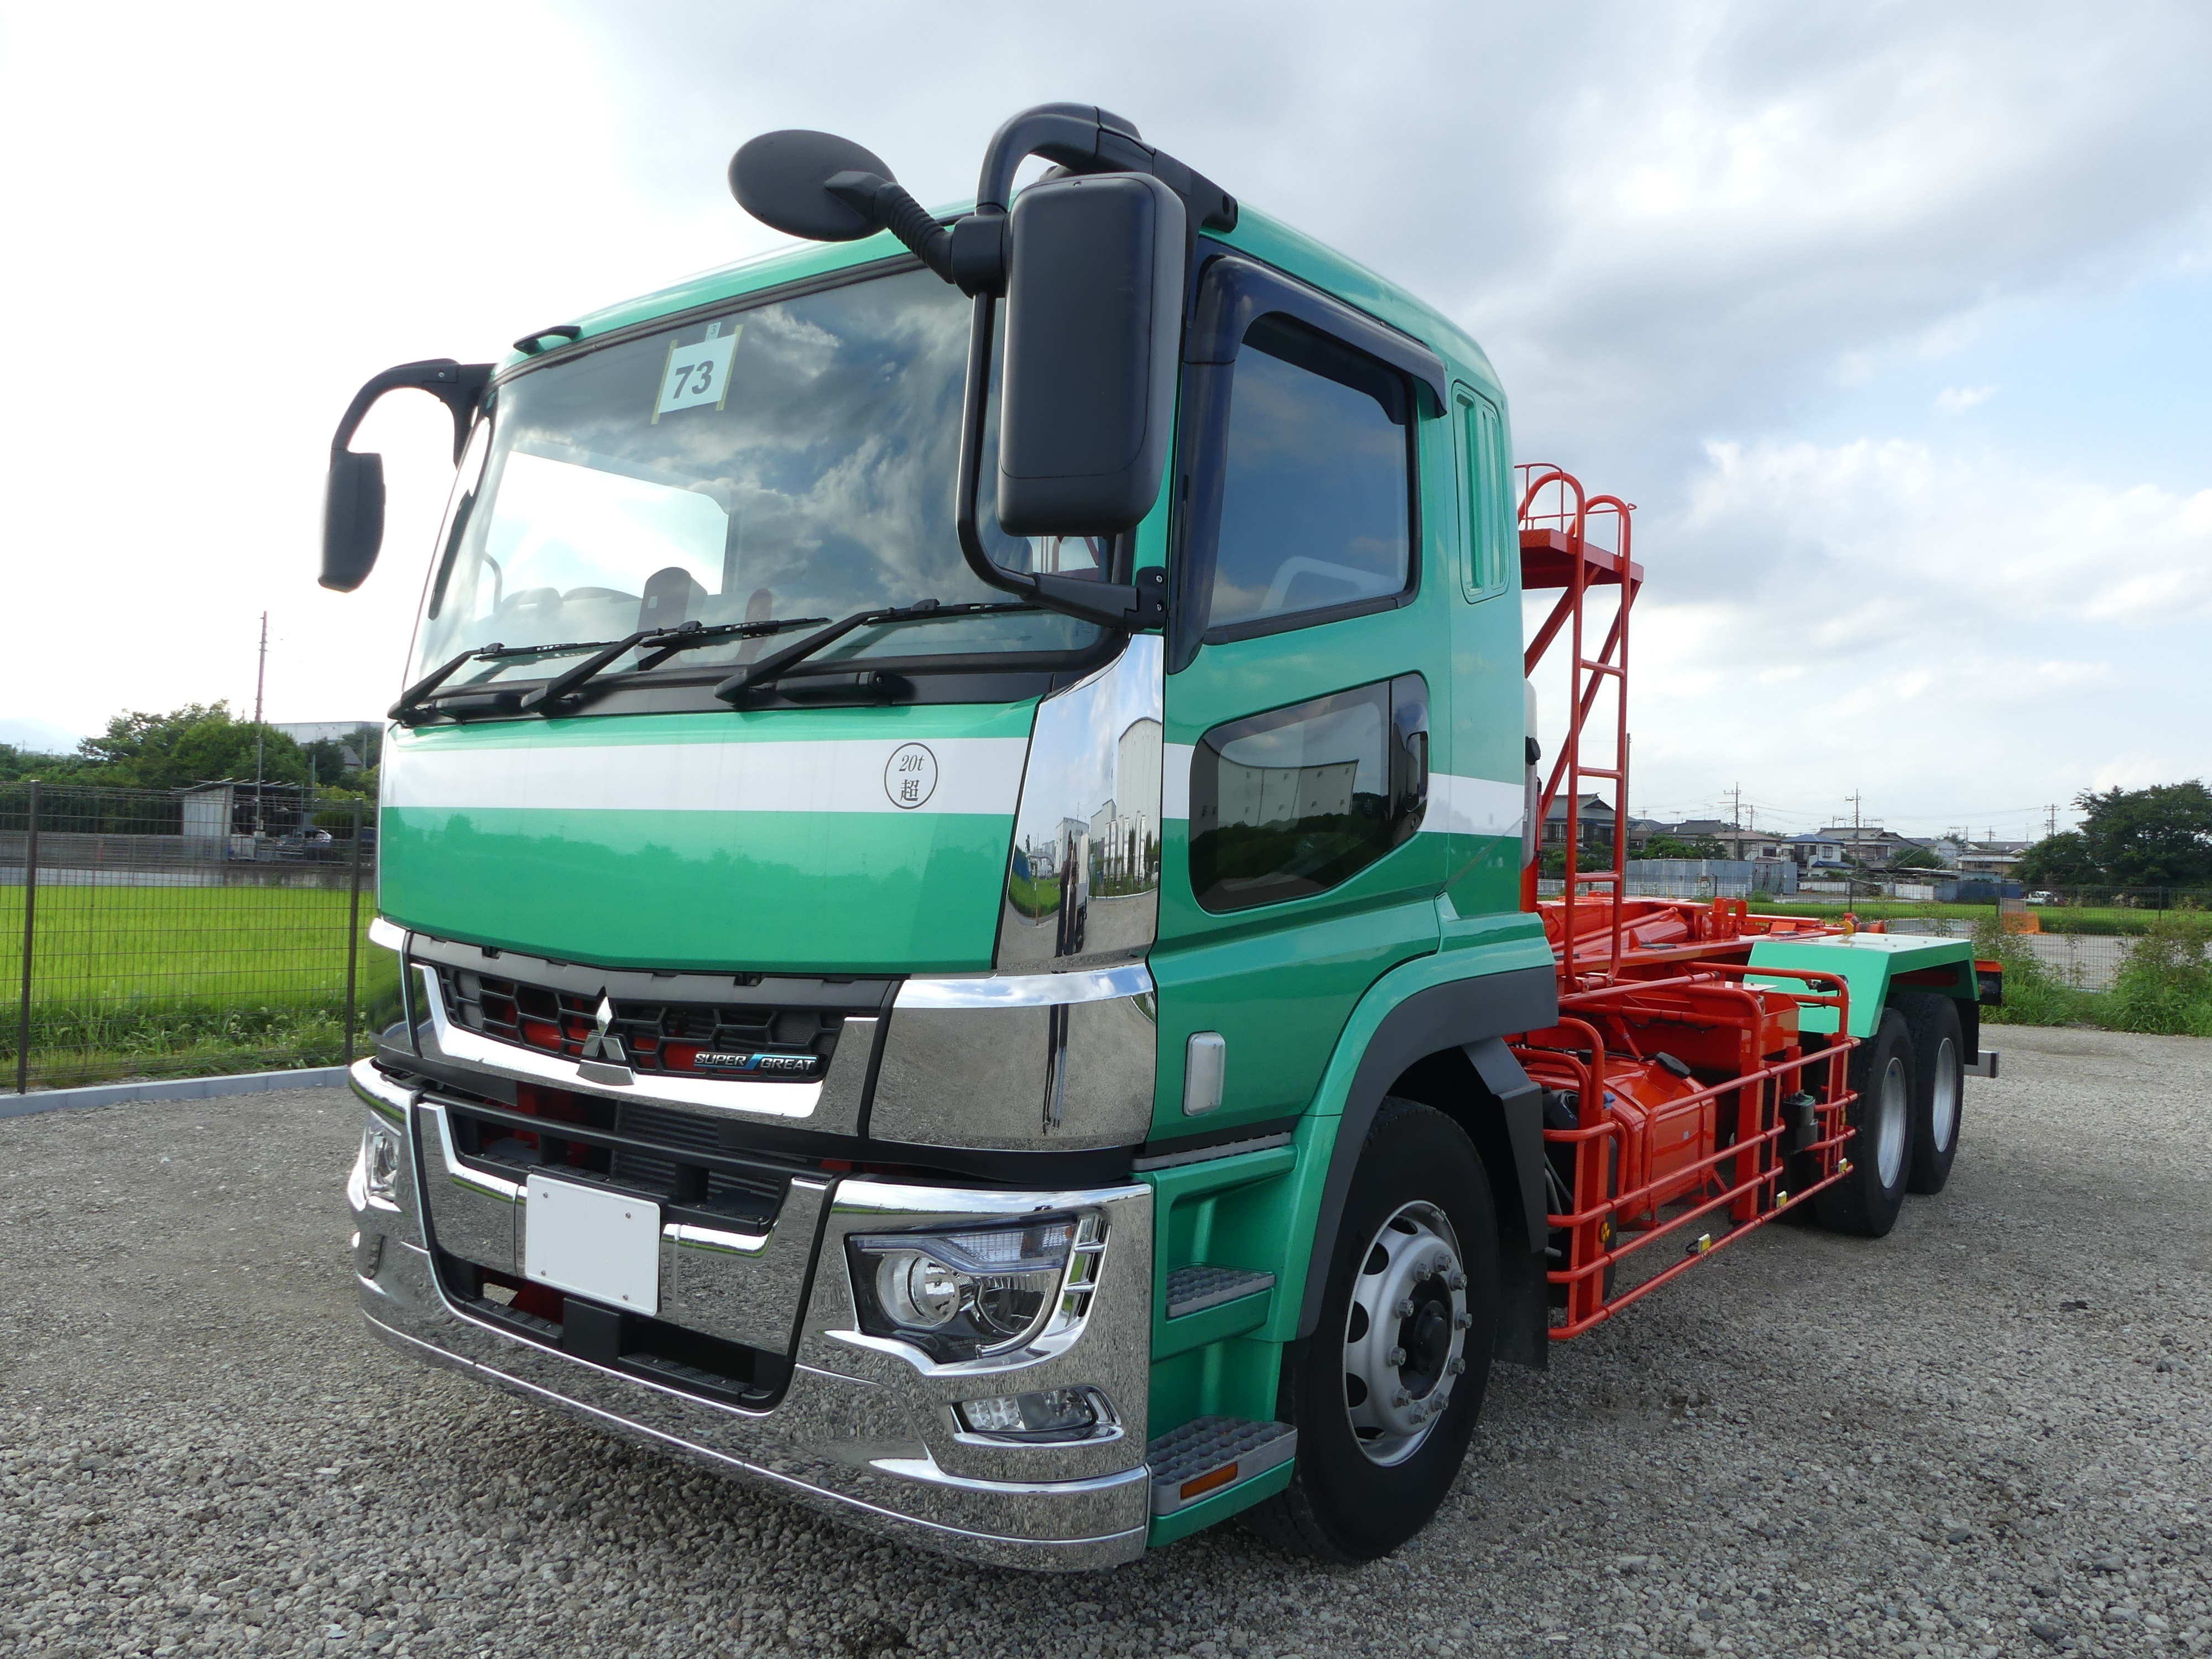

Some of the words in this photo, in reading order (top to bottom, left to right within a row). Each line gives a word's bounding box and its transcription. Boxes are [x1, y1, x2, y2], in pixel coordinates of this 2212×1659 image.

[672, 360, 714, 399] 73
[899, 754, 925, 772] 20t
[900, 779, 920, 802] 超
[694, 1053, 747, 1066] SUPER
[760, 1057, 816, 1070] GREAT
